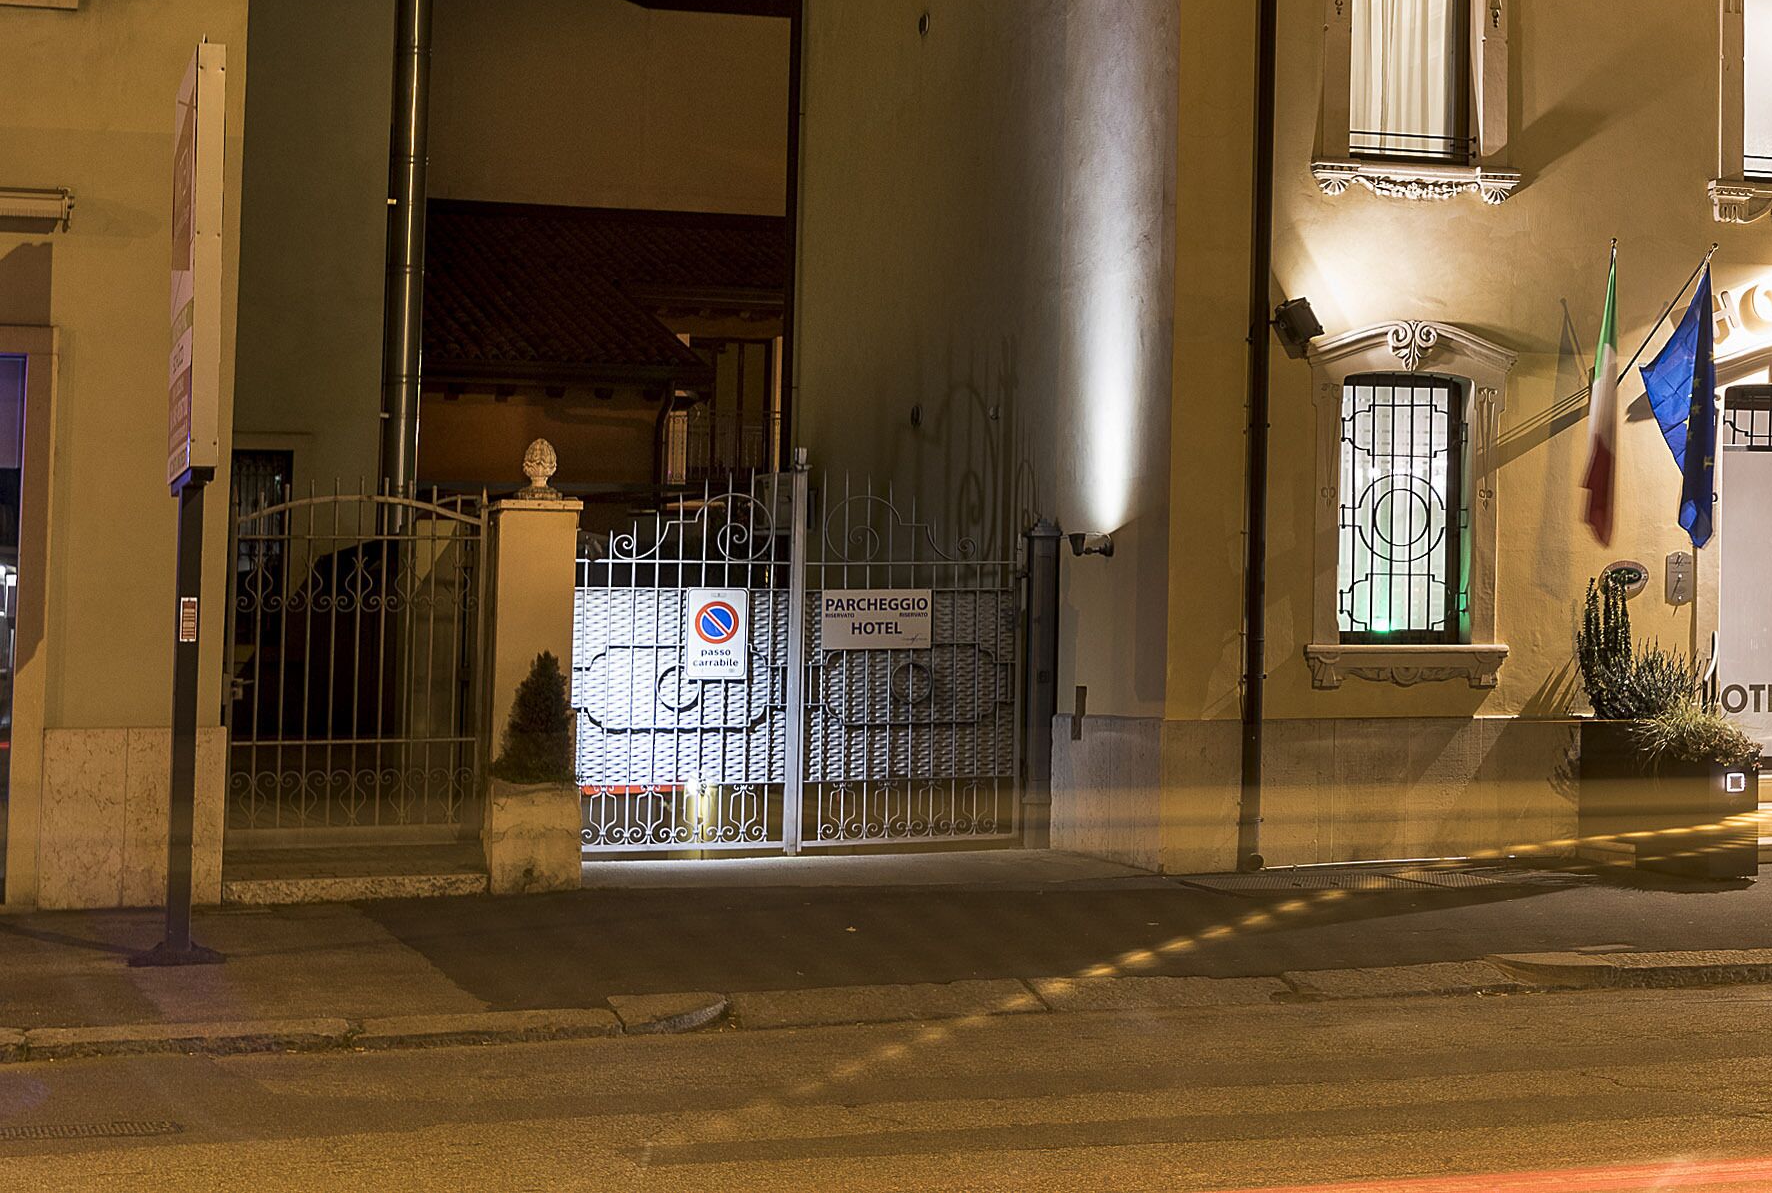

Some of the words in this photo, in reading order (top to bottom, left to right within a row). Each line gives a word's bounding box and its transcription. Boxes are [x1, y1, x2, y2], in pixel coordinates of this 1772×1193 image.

[825, 598, 929, 611] PARCHEGGIO
[851, 622, 902, 635] HOTEL
[701, 649, 731, 657] passo
[693, 658, 739, 667] carrabile
